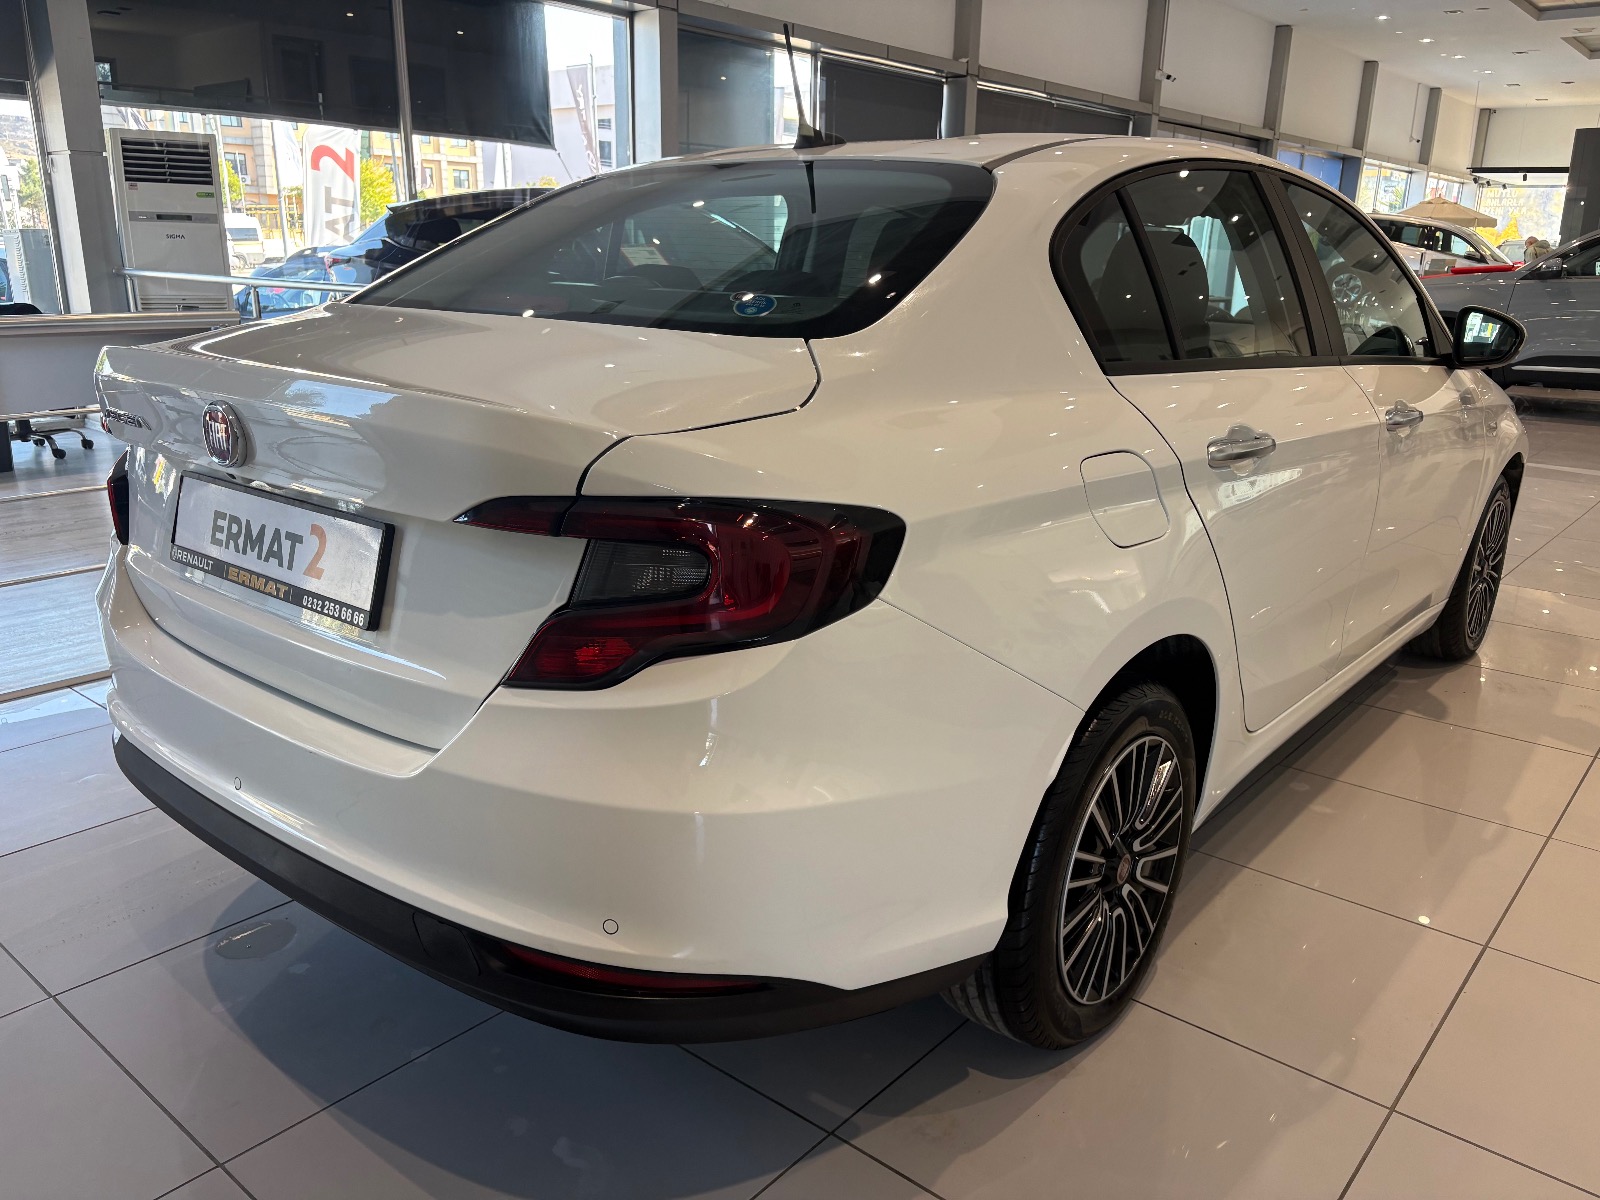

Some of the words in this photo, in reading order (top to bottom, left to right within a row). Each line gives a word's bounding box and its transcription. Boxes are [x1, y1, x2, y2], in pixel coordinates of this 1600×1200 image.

[310, 144, 355, 183] 2
[208, 420, 228, 451] FIAT
[176, 550, 214, 572] RENAULT
[210, 509, 304, 572] ERMAT
[303, 523, 327, 581] 2
[227, 566, 289, 600] ERMAT
[302, 595, 322, 612] 0232
[323, 600, 340, 617] 253
[340, 607, 353, 623] 66
[353, 612, 365, 627] 66
